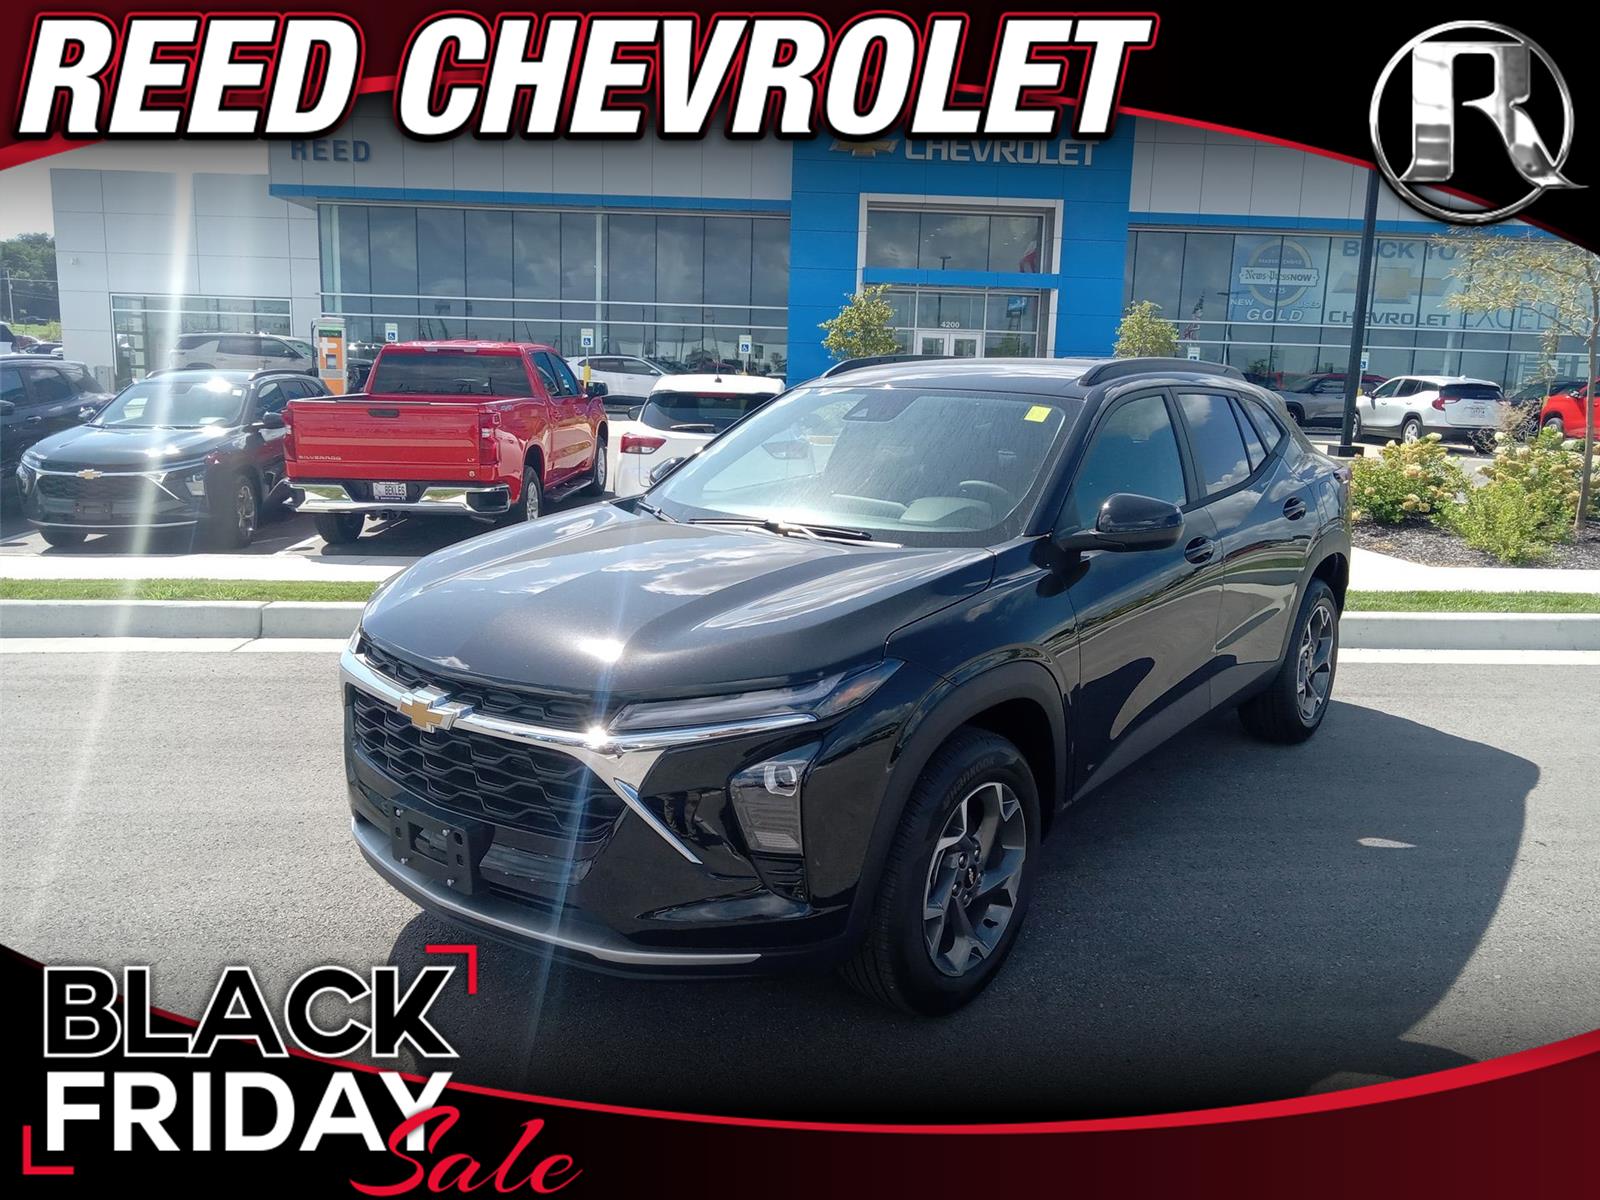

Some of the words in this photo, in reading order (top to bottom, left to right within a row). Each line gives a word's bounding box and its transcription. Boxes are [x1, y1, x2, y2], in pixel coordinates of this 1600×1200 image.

[290, 140, 371, 161] REED
[905, 139, 1099, 166] CHEVROLET
[1342, 240, 1415, 259] BCK
[1230, 298, 1254, 306] NEW
[1247, 308, 1304, 321] GOLD
[1328, 310, 1451, 327] CHVROLET
[940, 321, 960, 329] 4200
